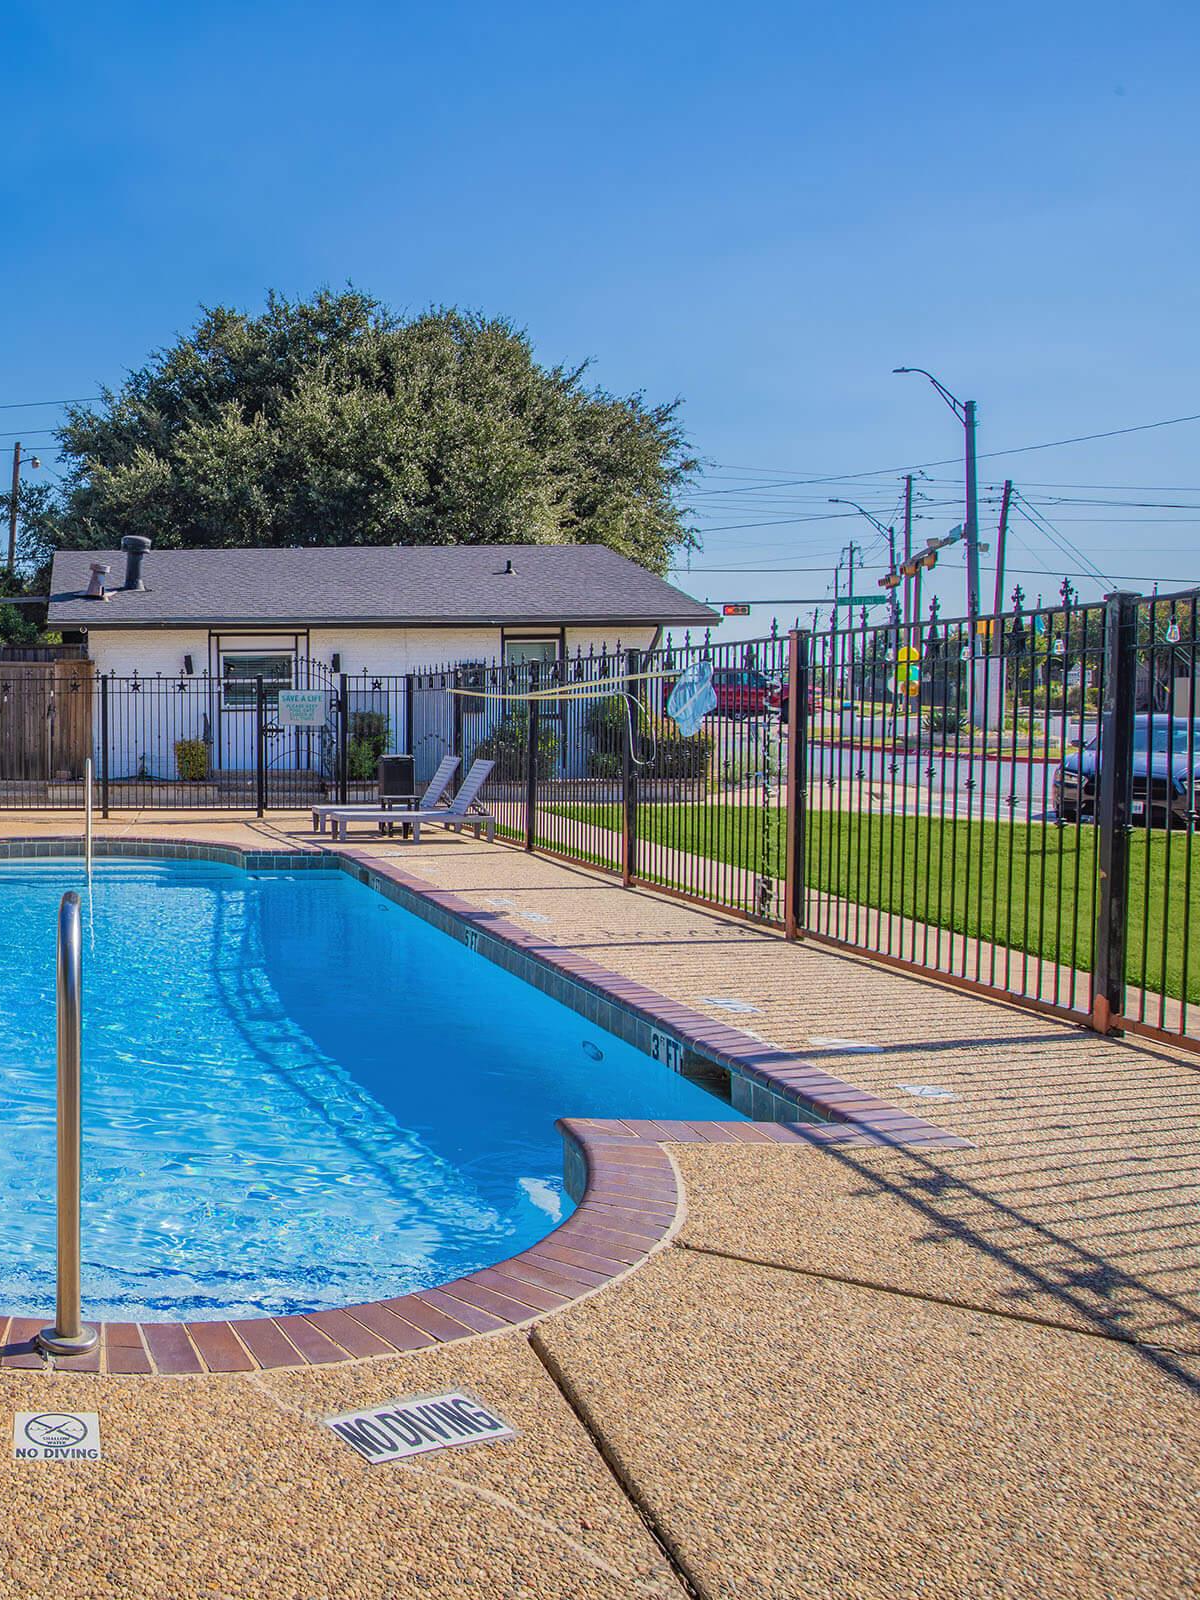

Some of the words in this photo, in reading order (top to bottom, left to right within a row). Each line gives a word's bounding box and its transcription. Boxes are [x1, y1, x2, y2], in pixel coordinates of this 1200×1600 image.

[652, 1033, 660, 1060] 3
[666, 1038, 680, 1073] FT
[332, 1418, 400, 1457] NO
[374, 1398, 504, 1448] DIVING
[15, 1448, 38, 1458] NO
[44, 1448, 99, 1459] DIVING
